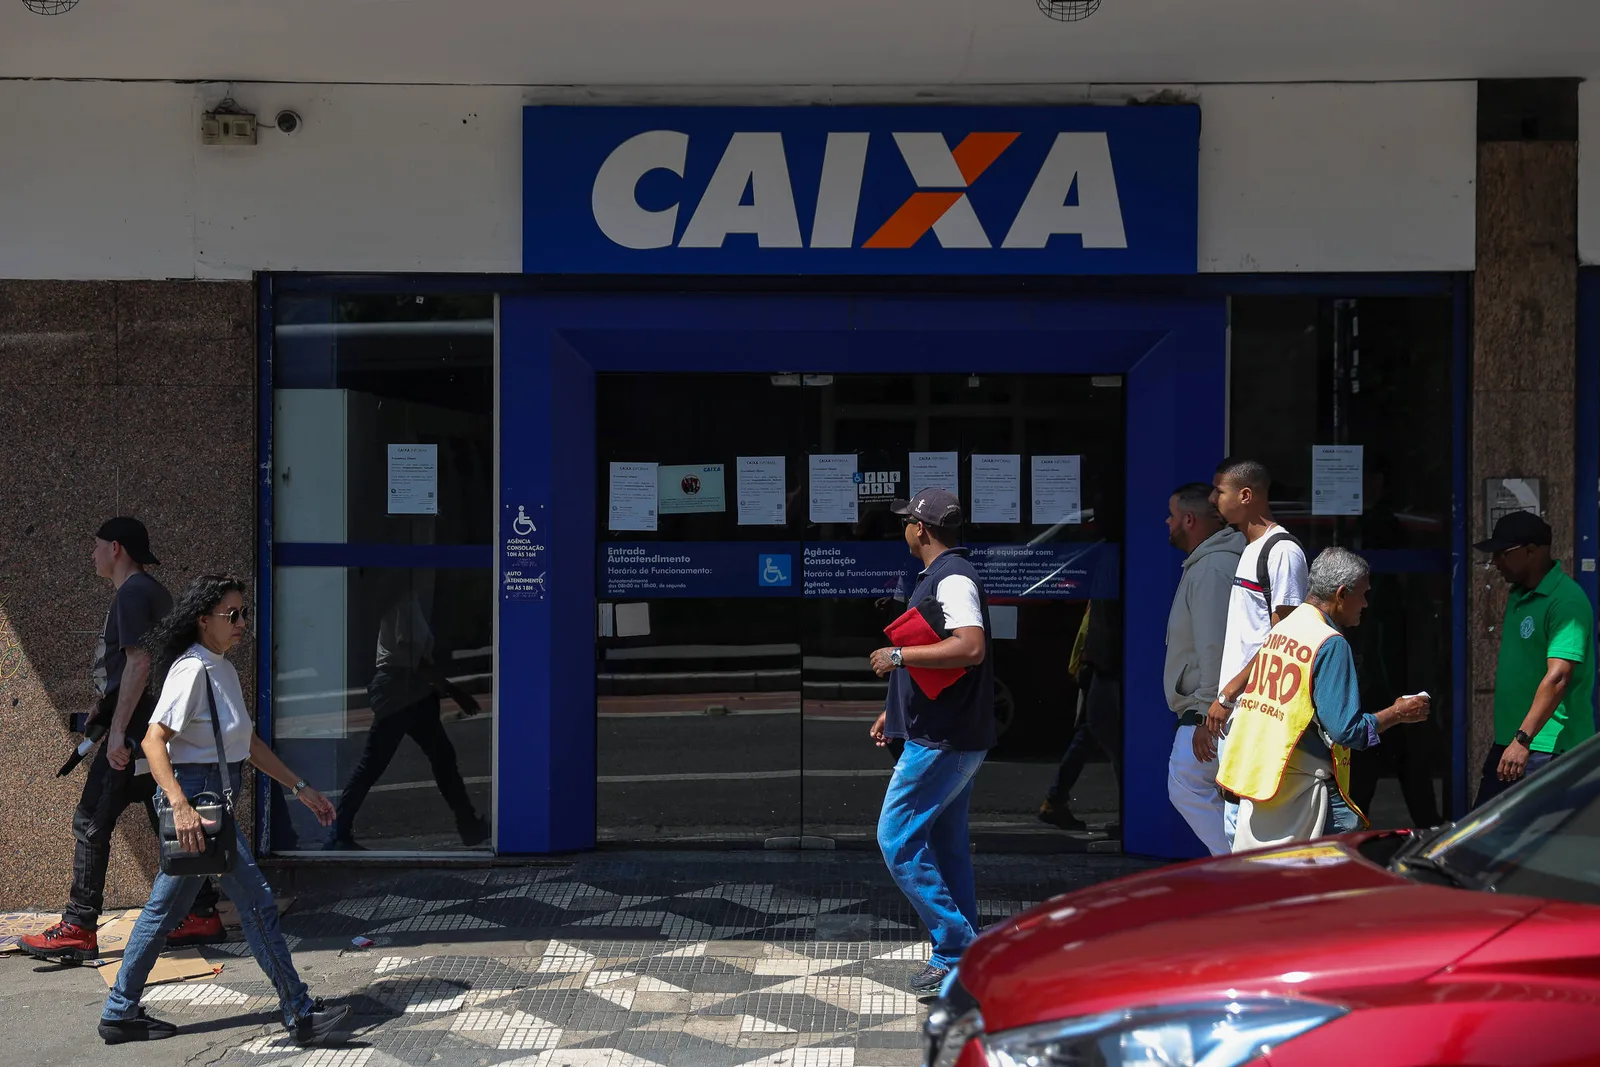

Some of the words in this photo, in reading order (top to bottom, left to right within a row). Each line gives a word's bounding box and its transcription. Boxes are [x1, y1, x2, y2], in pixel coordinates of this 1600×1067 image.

[592, 130, 1128, 249] CAIXA
[608, 547, 645, 555] Entrada
[804, 548, 840, 557] Agência
[970, 548, 994, 557] gência
[996, 548, 1034, 557] equipada
[608, 555, 691, 563] Autoatendimento
[804, 557, 856, 566] Consolação
[804, 569, 833, 577] Horário
[835, 569, 845, 577] de
[847, 569, 908, 577] Funcionamento:
